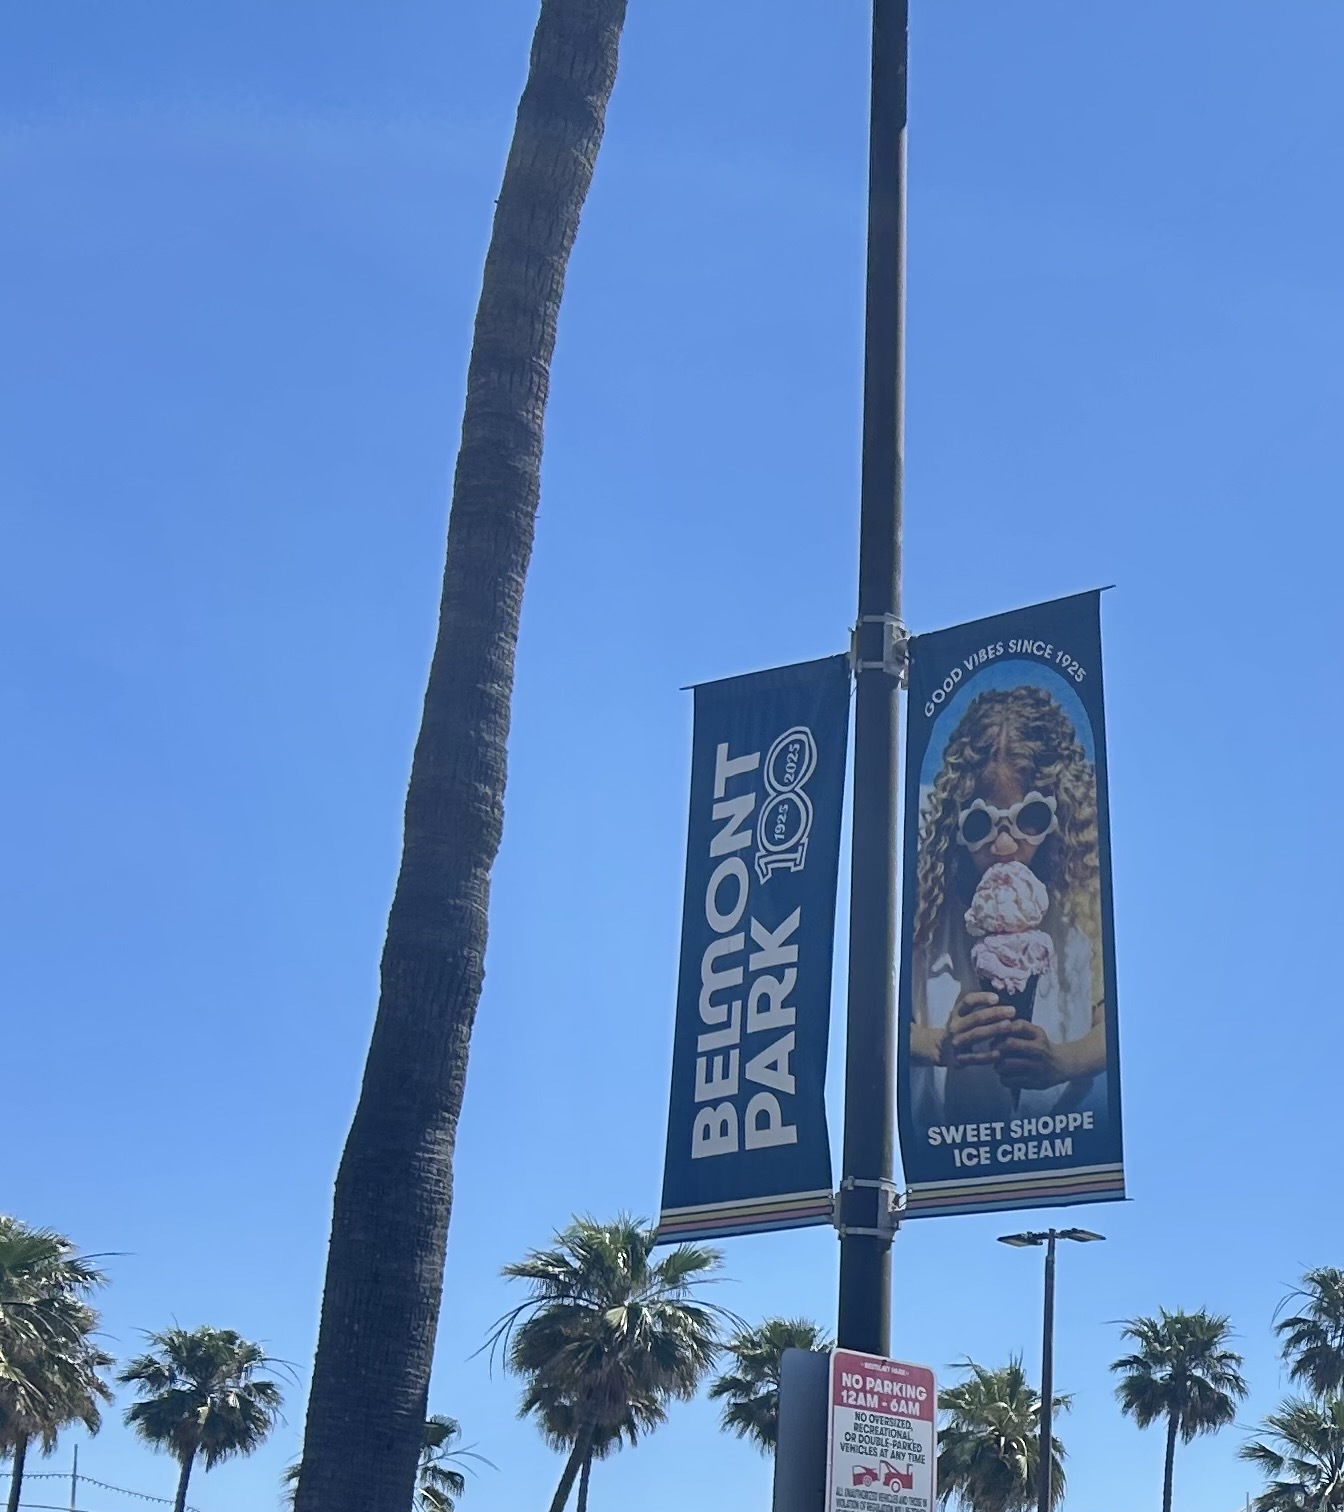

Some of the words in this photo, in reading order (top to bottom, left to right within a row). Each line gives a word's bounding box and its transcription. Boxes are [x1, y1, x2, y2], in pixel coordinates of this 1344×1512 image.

[924, 667, 963, 718] GOOD
[963, 641, 1004, 671] VIBES
[1008, 639, 1053, 659] SINCE
[1055, 651, 1087, 683] 1925
[783, 743, 800, 783] 2025
[754, 726, 818, 885] 100
[774, 804, 789, 841] 1925
[743, 904, 801, 1151] PARK
[928, 1122, 1005, 1146] SWEET
[1010, 1111, 1094, 1138] SHOPPE
[953, 1146, 991, 1167] ICE
[996, 1137, 1073, 1163] CREAM
[841, 1372, 863, 1389] NO
[866, 1376, 927, 1401] PARKING
[841, 1389, 879, 1408] 12AM
[890, 1398, 920, 1416] 6AM
[854, 1411, 867, 1422] NO
[844, 1431, 857, 1442] OR
[840, 1442, 878, 1457] VEHICLES
[880, 1448, 889, 1458] AT
[890, 1450, 906, 1461] ANY
[907, 1452, 926, 1464] TIME
